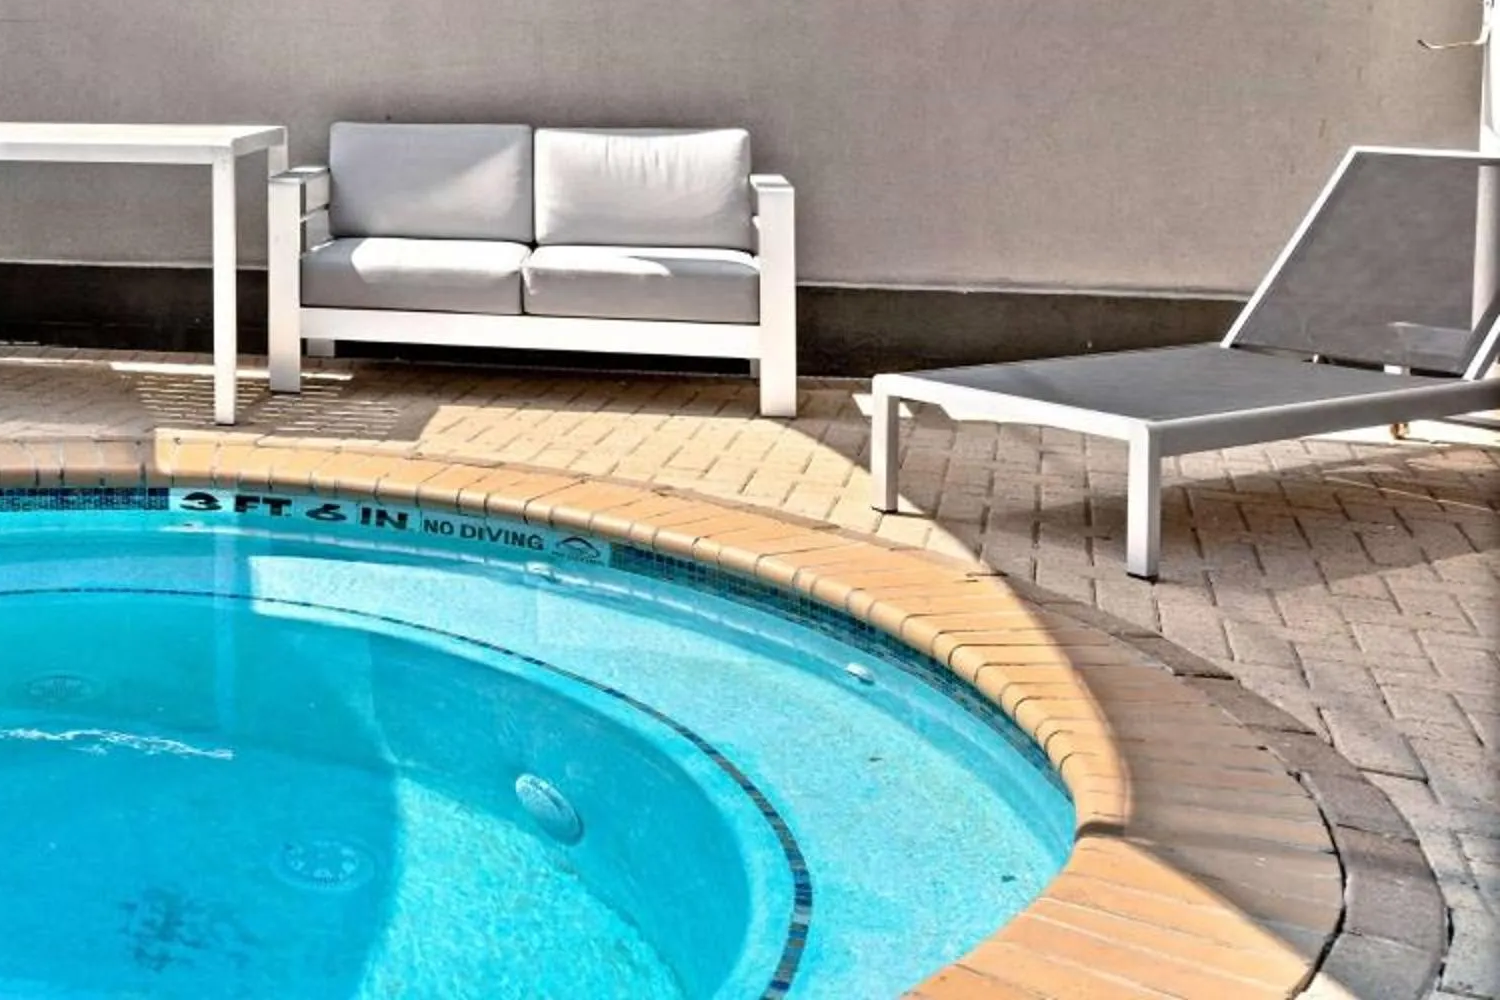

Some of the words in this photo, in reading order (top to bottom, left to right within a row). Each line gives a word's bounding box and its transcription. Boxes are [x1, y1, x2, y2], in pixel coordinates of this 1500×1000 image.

[179, 491, 222, 511] 3
[305, 503, 347, 521] 6
[423, 518, 455, 535] NO
[460, 524, 545, 551] DIVING
